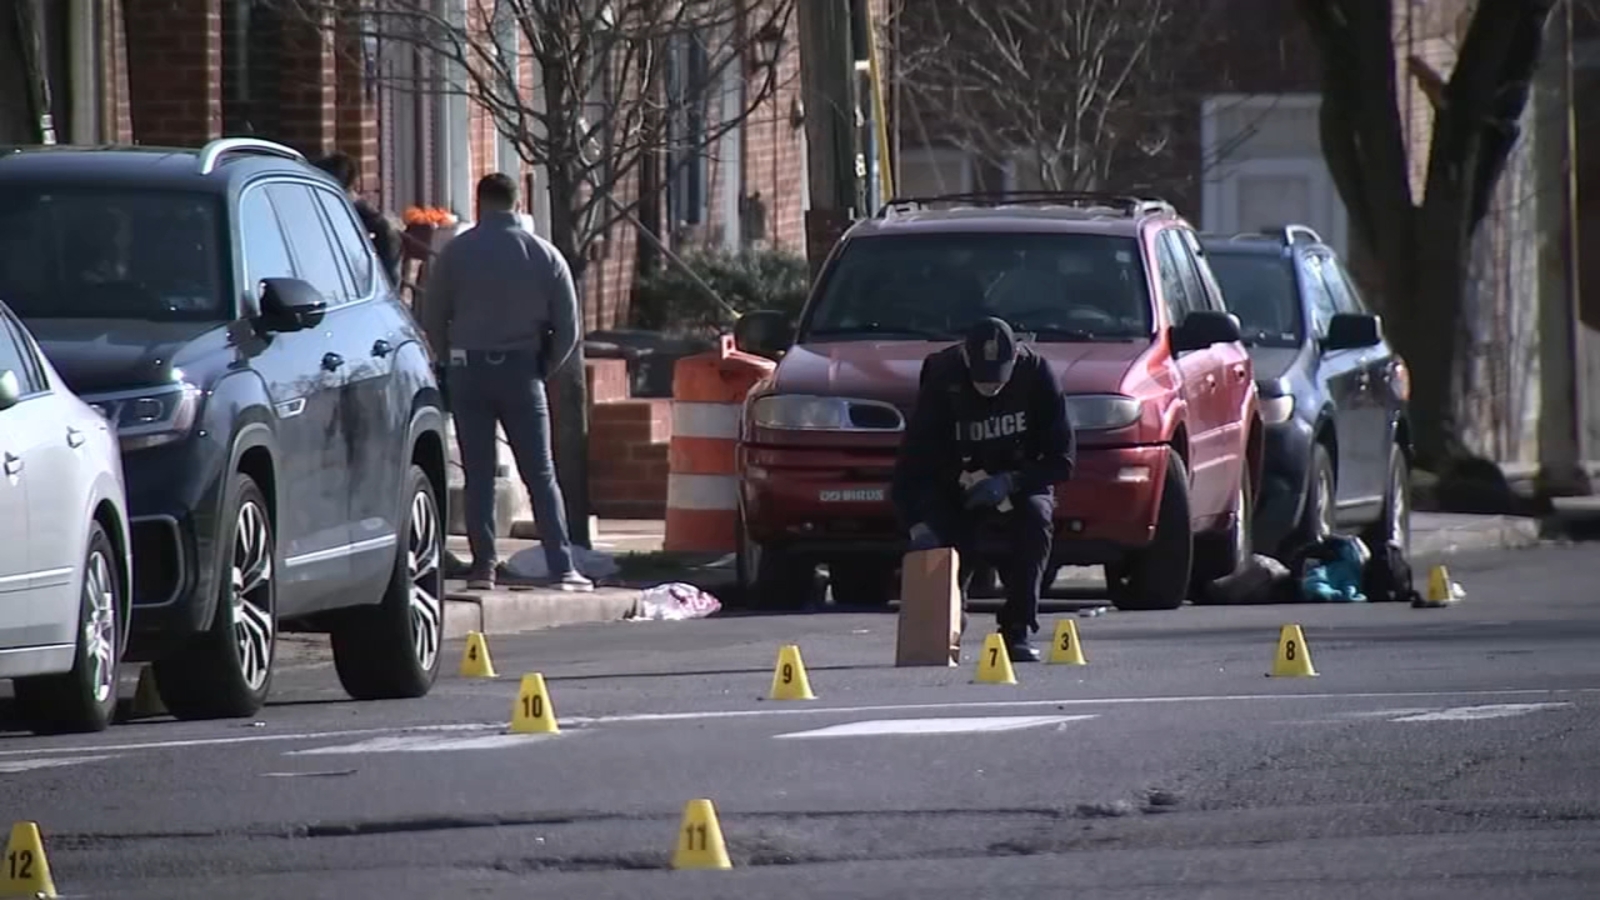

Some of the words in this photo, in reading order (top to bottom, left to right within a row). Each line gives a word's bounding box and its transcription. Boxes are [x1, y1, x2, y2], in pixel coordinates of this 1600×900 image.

[1060, 632, 1069, 651] 3
[1285, 639, 1296, 661] 8
[469, 645, 477, 661] 4
[989, 647, 998, 668] 7
[782, 663, 793, 684] 9
[522, 694, 543, 718] 10
[685, 823, 707, 851] 11
[8, 850, 33, 880] 12
